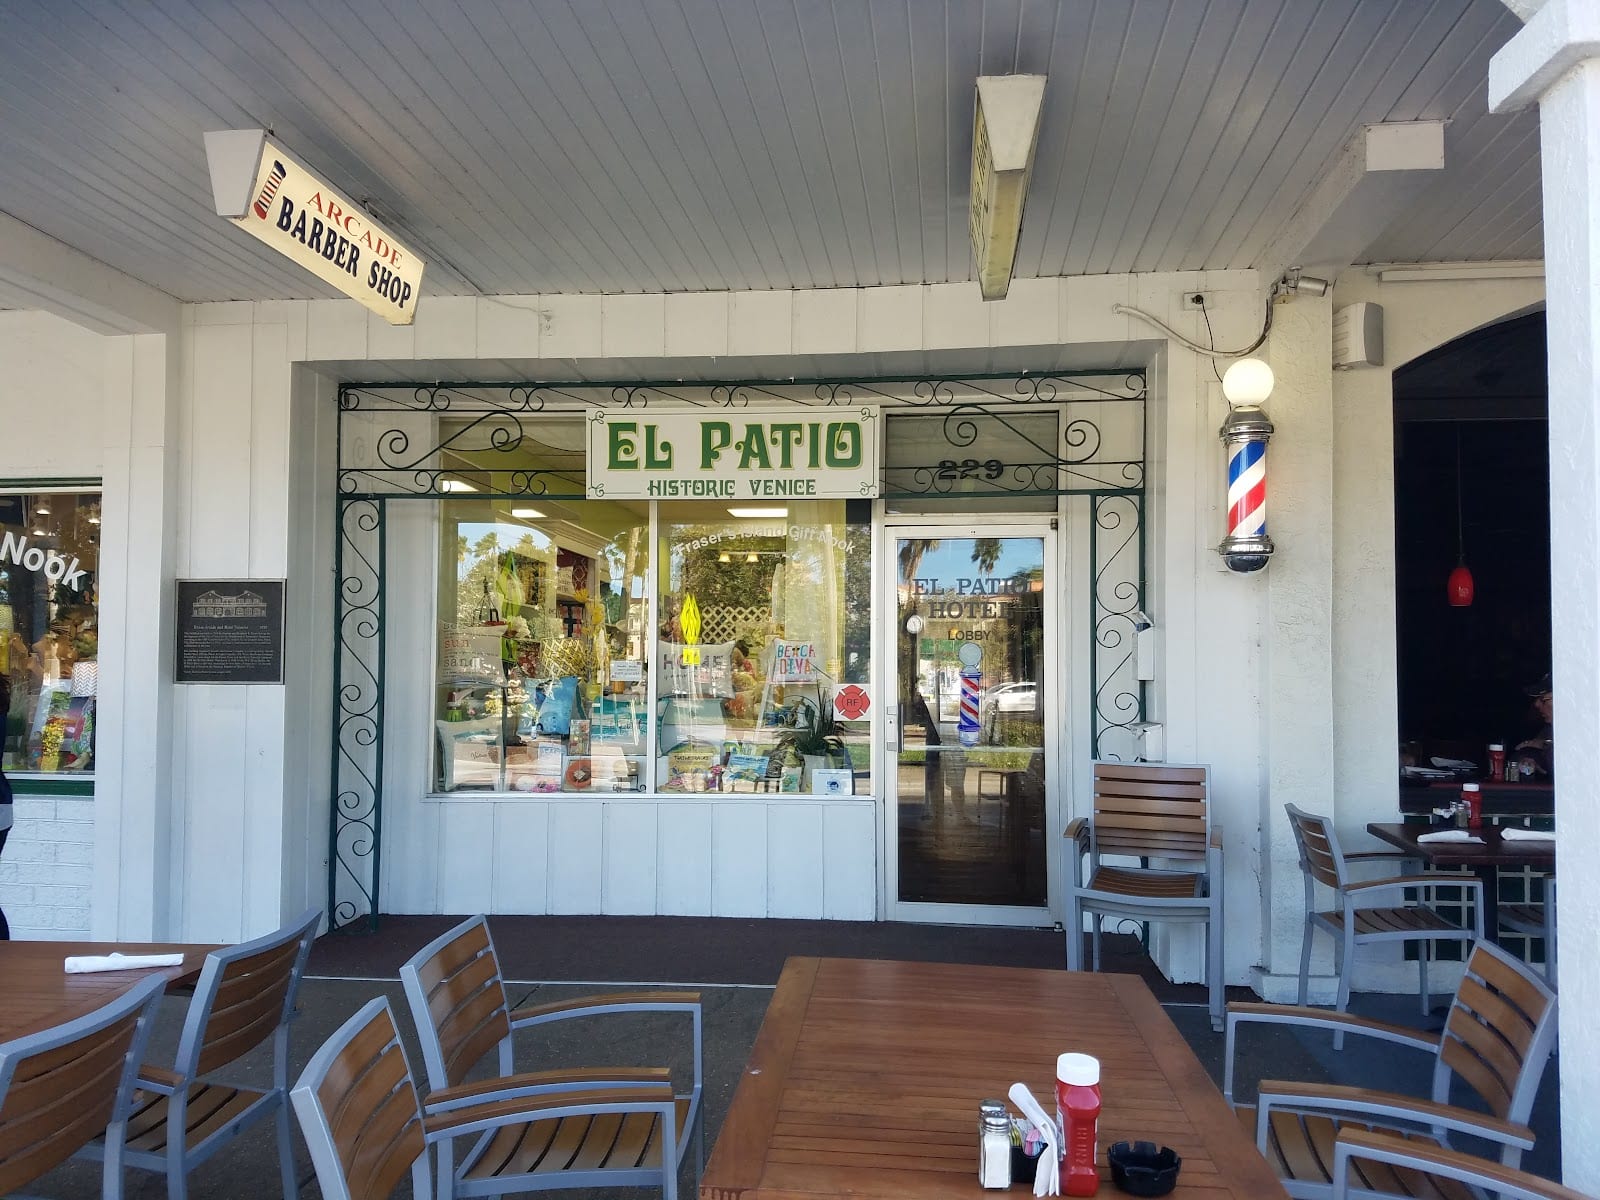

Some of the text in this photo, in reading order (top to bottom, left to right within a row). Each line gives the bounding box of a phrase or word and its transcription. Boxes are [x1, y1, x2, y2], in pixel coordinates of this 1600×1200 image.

[307, 191, 403, 270] ARCADE
[276, 195, 412, 309] BARBER SHOP
[606, 421, 864, 471] EL PATIO
[937, 458, 1005, 480] 229
[647, 479, 817, 499] HISTORIC VENICE
[673, 528, 737, 557] Fraser's
[788, 525, 818, 542] Gift
[0, 531, 88, 592] Nook
[912, 578, 1030, 596] EL PATIO
[928, 601, 1014, 619] HOTEL
[947, 630, 992, 641] LOBBY
[780, 658, 812, 674] DIVA
